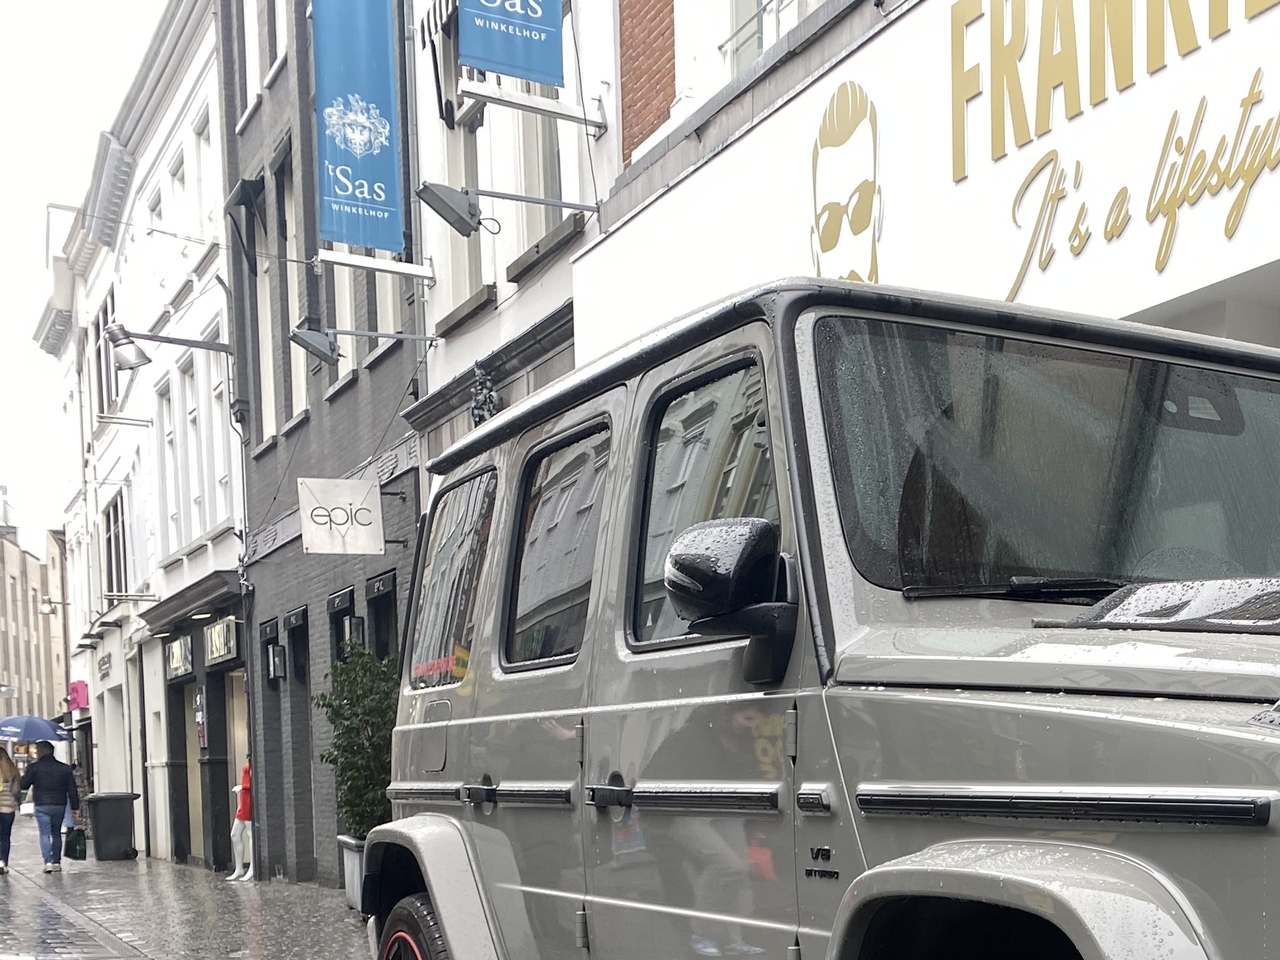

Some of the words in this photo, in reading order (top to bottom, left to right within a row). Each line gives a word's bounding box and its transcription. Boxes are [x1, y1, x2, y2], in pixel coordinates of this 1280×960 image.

[480, 0, 543, 18] as
[474, 17, 547, 41] WINKELHOF
[331, 203, 389, 219] WINKELHOF
[1005, 149, 1092, 303] It's
[1104, 186, 1132, 242] a
[310, 503, 373, 531] epic
